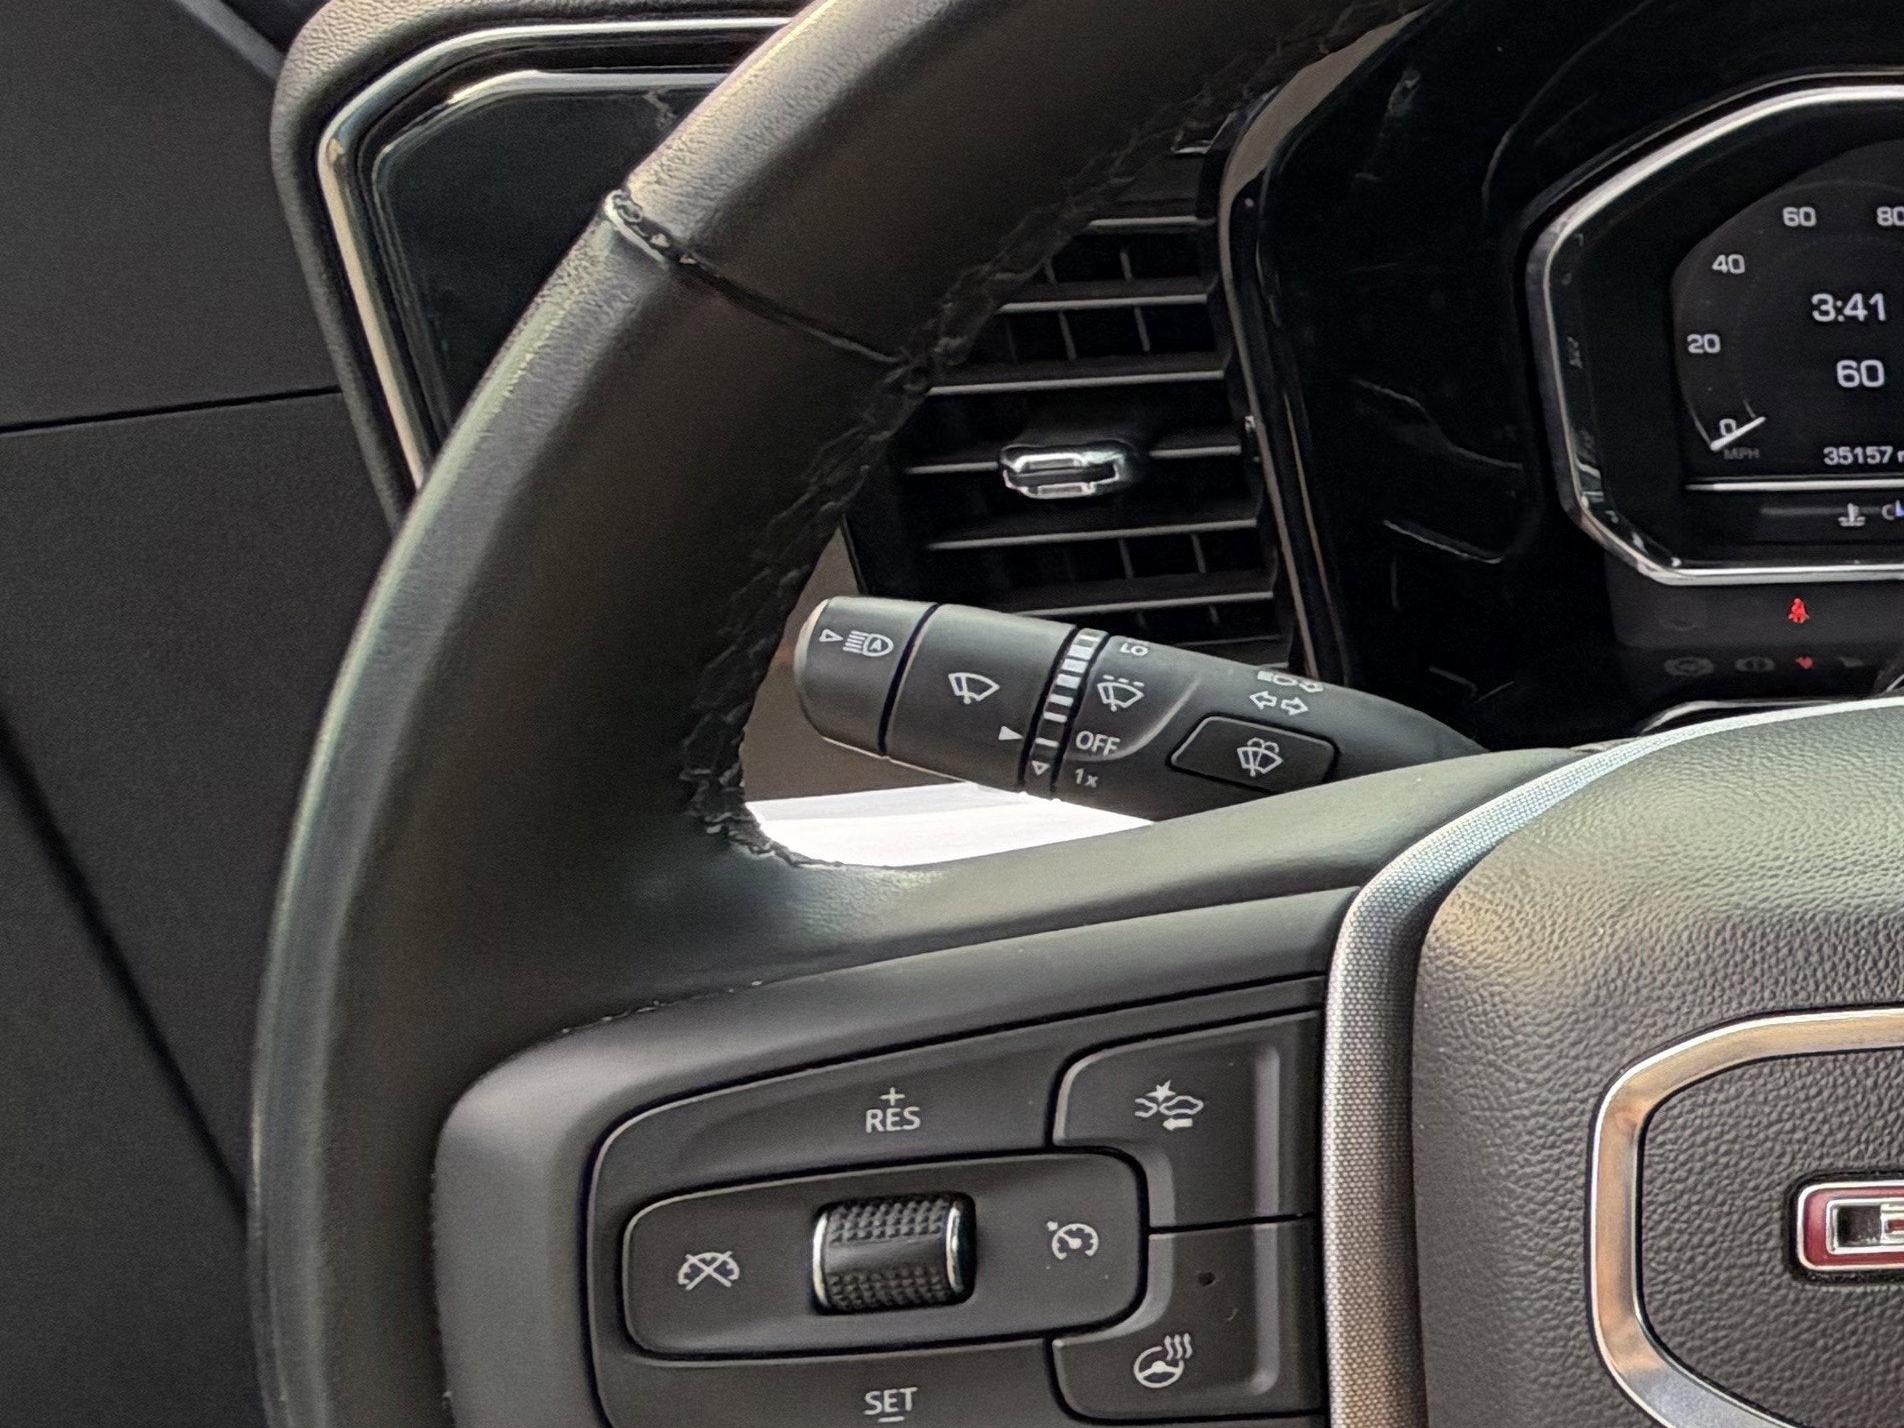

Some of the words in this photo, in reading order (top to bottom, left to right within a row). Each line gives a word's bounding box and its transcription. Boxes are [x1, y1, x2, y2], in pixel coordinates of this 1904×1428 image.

[1783, 206, 1817, 228] 60
[1712, 253, 1746, 275] 40
[1811, 293, 1887, 323] 3:41
[1687, 333, 1722, 354] 20
[1836, 359, 1885, 388] 60
[1719, 418, 1737, 437] 0
[1723, 447, 1760, 460] MPH
[1823, 446, 1894, 466] 35157
[1119, 642, 1149, 657] LO
[1075, 730, 1121, 756] OFF
[1074, 767, 1099, 788] 1x
[865, 1105, 922, 1134] RES
[863, 1386, 918, 1416] SET
